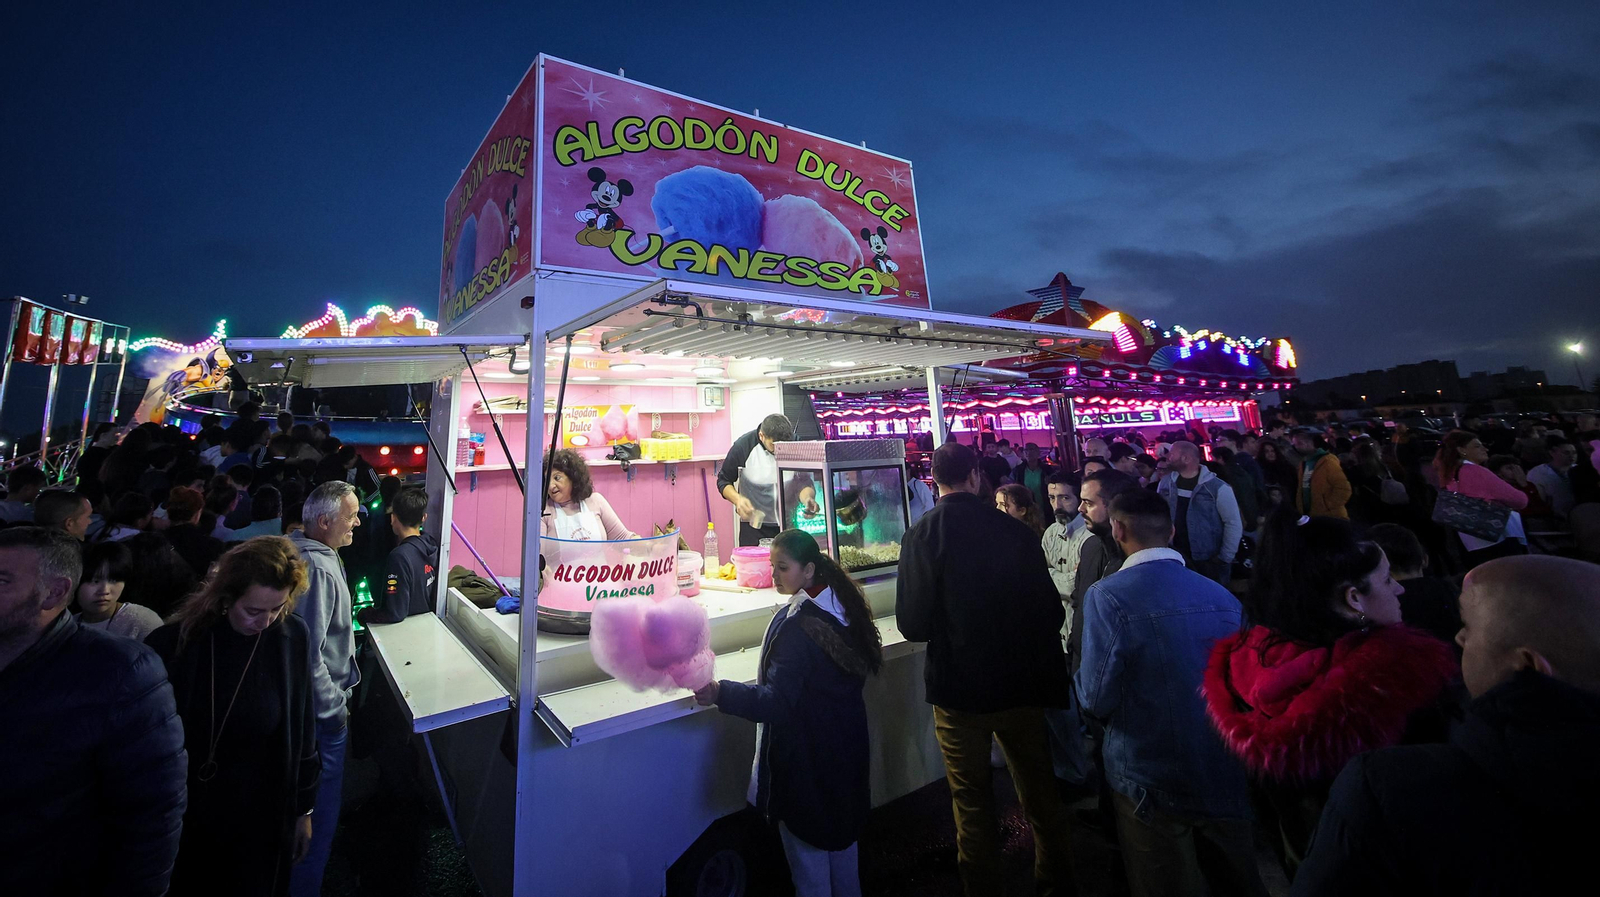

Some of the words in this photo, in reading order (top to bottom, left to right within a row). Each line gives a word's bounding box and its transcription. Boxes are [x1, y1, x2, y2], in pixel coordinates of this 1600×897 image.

[486, 135, 532, 179] DULCE
[553, 115, 779, 167] ALGODÓN
[796, 148, 911, 232] DULCE
[444, 247, 512, 326] VANESSA
[609, 229, 884, 295] VANESSA
[569, 421, 592, 433] Dulce
[554, 563, 636, 583] ALGODON
[637, 555, 675, 580] DULCE
